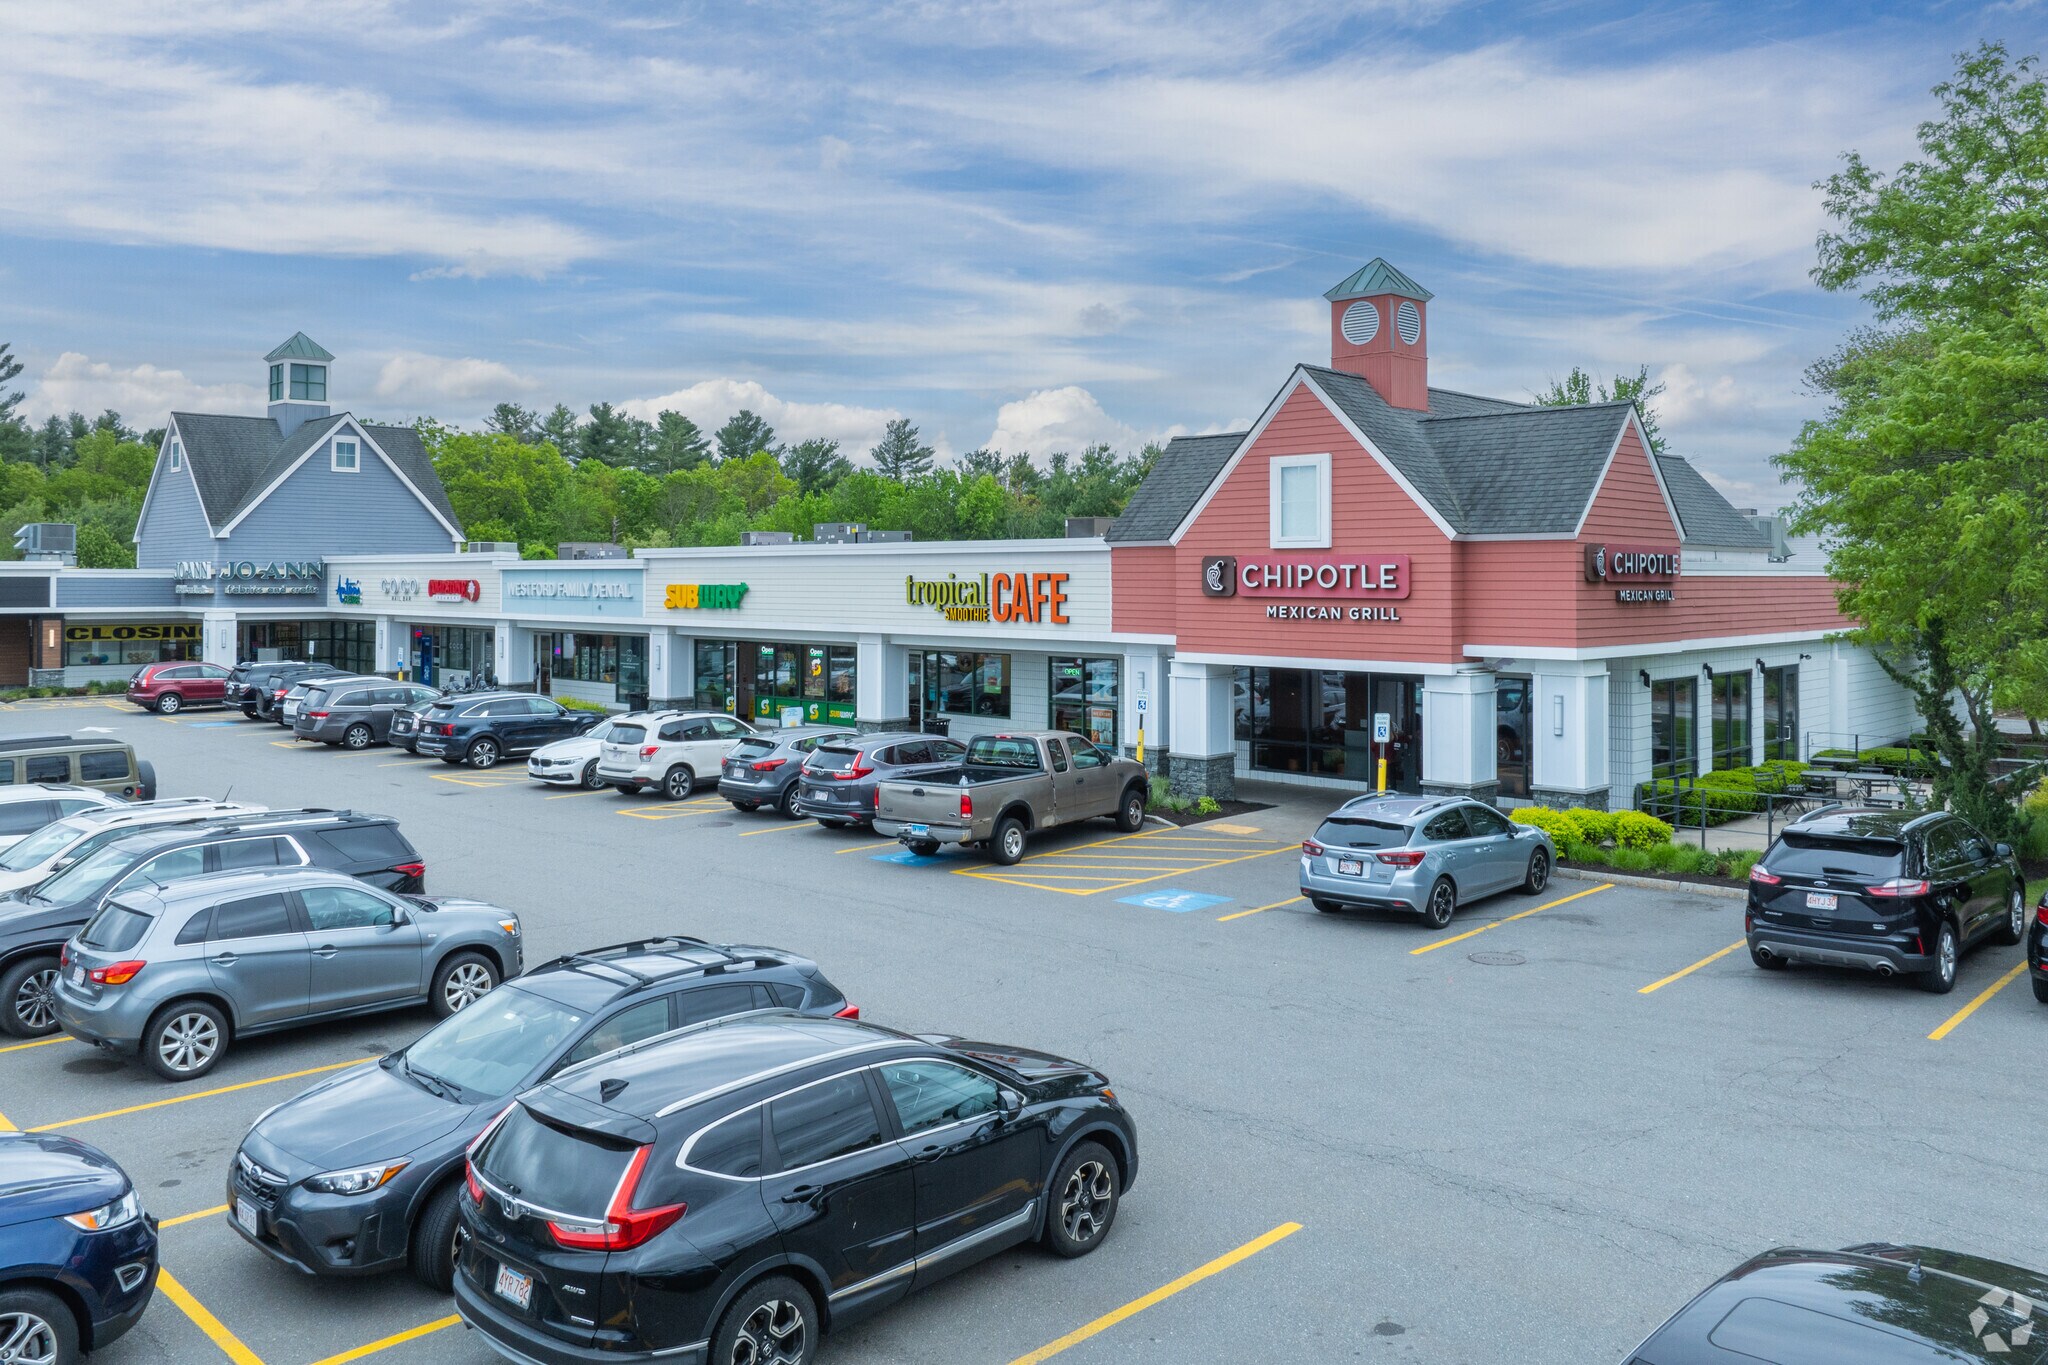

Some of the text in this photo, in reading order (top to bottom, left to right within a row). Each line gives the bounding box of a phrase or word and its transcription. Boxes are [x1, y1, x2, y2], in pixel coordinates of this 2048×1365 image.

[1614, 552, 1680, 574] CHIPOTLE
[1241, 563, 1398, 590] CHIPOTLE
[268, 585, 286, 594] and
[507, 582, 633, 600] WESTFORD FAMILY DENTAL
[664, 582, 750, 609] SUBWAY
[905, 573, 989, 611] tropical
[1620, 590, 1675, 602] MEXICAN GRILL
[992, 573, 1069, 624] CAFE
[944, 607, 989, 622] SMOOTHIE
[1266, 605, 1400, 621] MEXICAN GRILL
[66, 626, 203, 640] CLOSIN
[810, 648, 823, 656] Open
[1064, 668, 1080, 676] OPEN
[829, 710, 854, 719] SUBWAY
[562, 1284, 586, 1295] AWD
